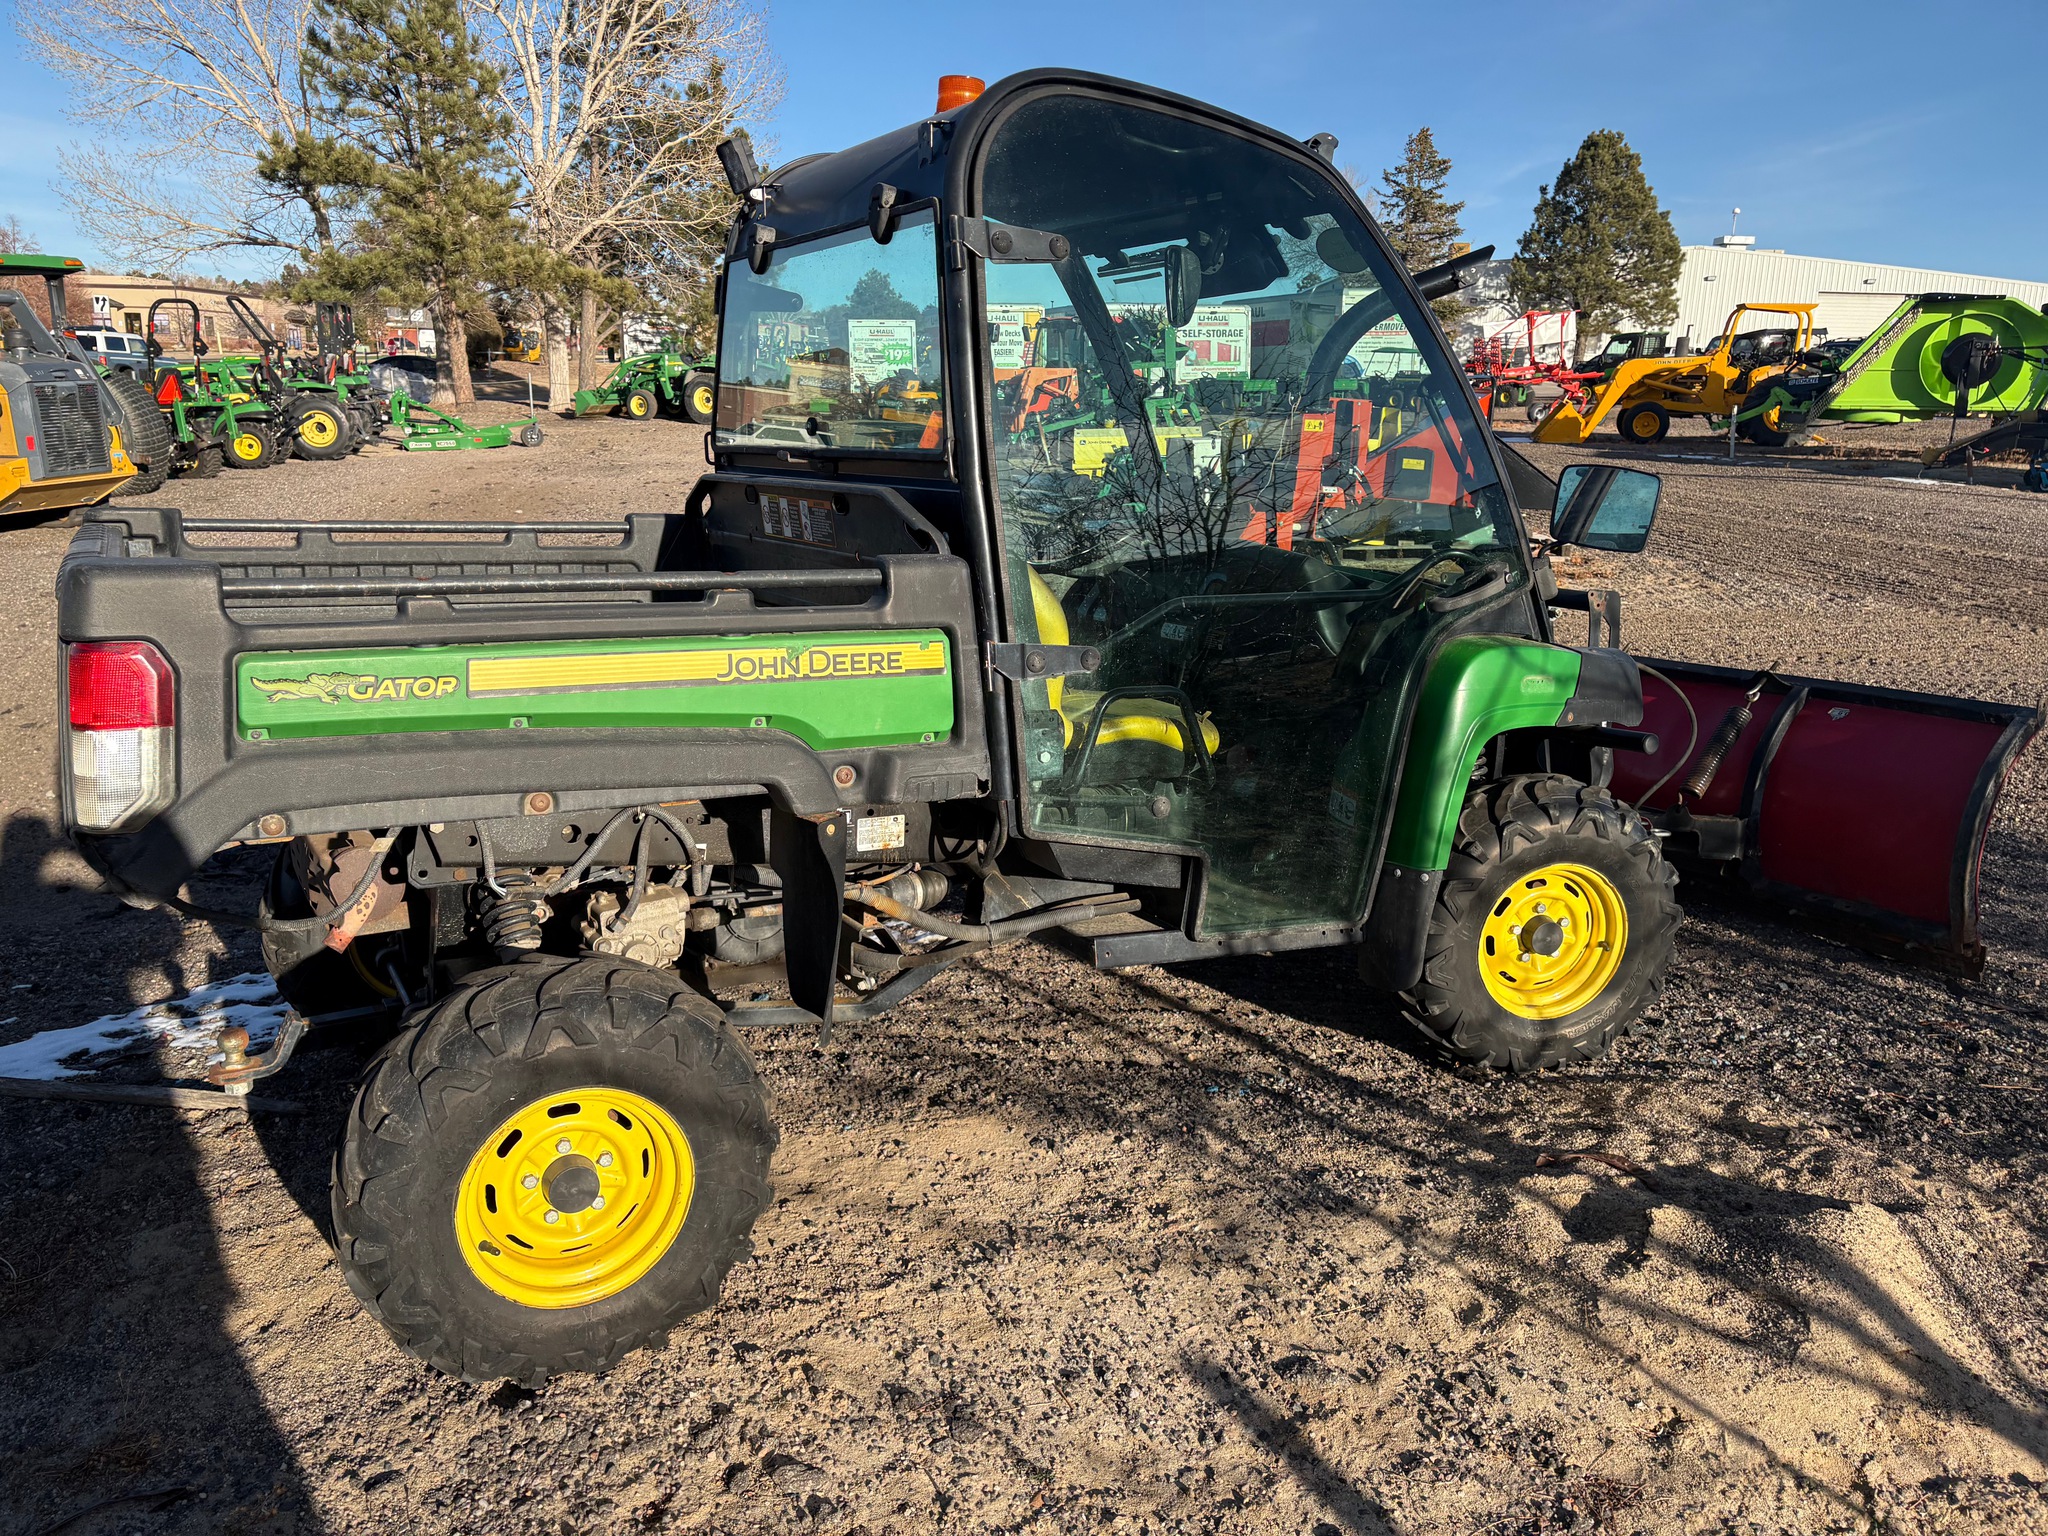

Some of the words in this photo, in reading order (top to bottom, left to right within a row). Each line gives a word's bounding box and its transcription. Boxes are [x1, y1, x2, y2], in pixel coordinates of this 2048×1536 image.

[1182, 329, 1244, 338] SELF-STORAGE
[716, 652, 800, 679] JOHN
[808, 650, 904, 674] DEERE
[347, 675, 460, 702] GATOR
